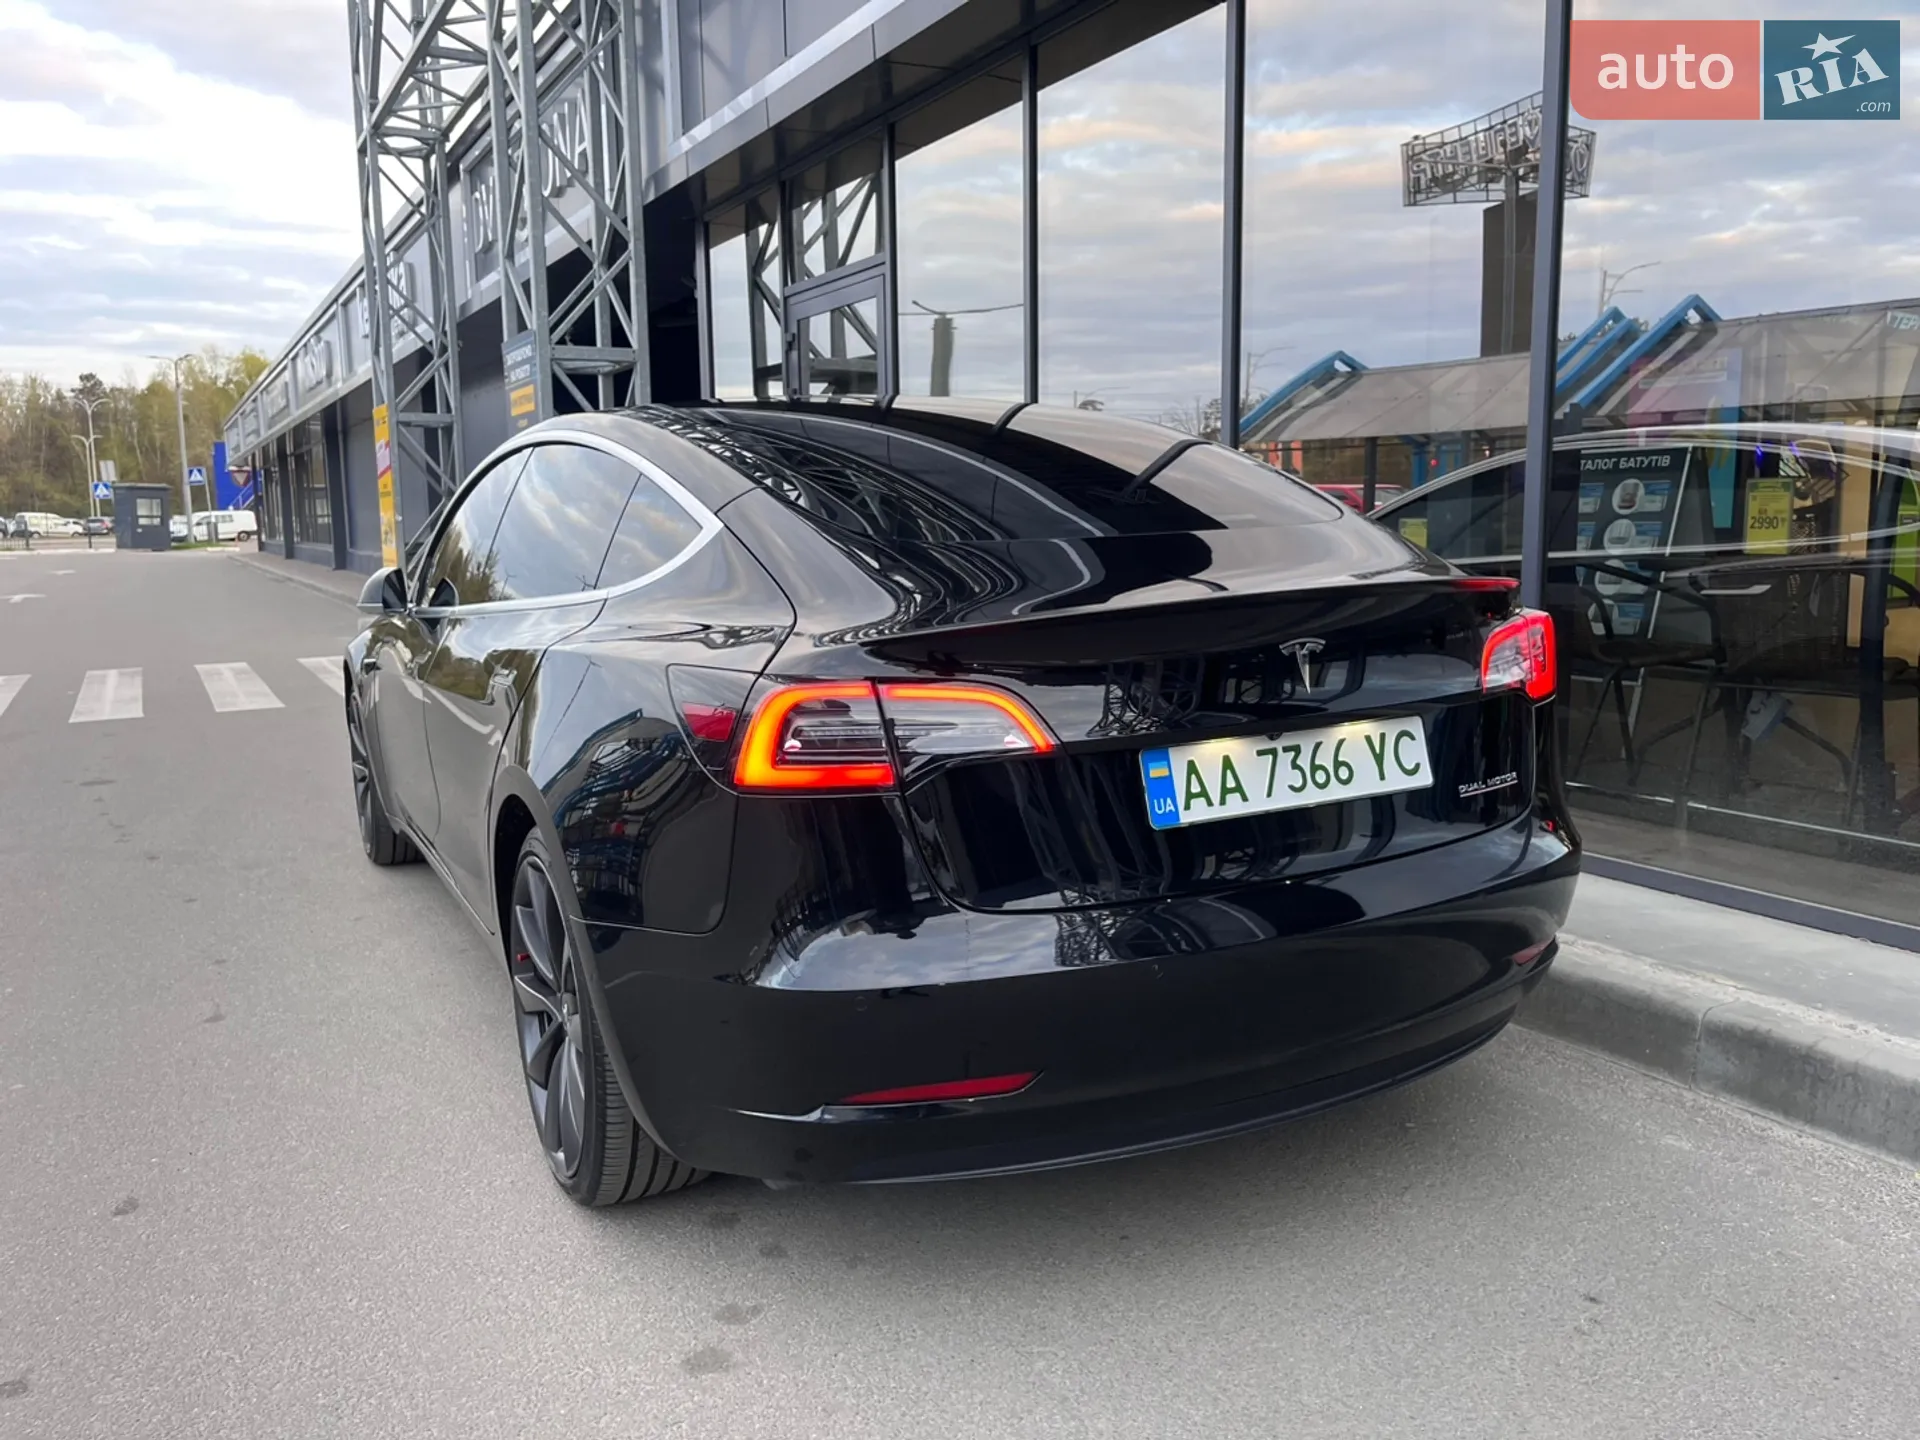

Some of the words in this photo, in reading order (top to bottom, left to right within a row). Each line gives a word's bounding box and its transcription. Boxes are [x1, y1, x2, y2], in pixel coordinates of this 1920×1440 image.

[1619, 455, 1671, 469] БАТУТІВ
[1750, 516, 1779, 530] 2990
[1183, 755, 1249, 811] AA
[1256, 737, 1354, 799] 7366
[1364, 729, 1421, 782] YC
[1458, 781, 1486, 794] DUAL
[1487, 771, 1518, 787] MOTOR
[1154, 798, 1175, 815] UA
